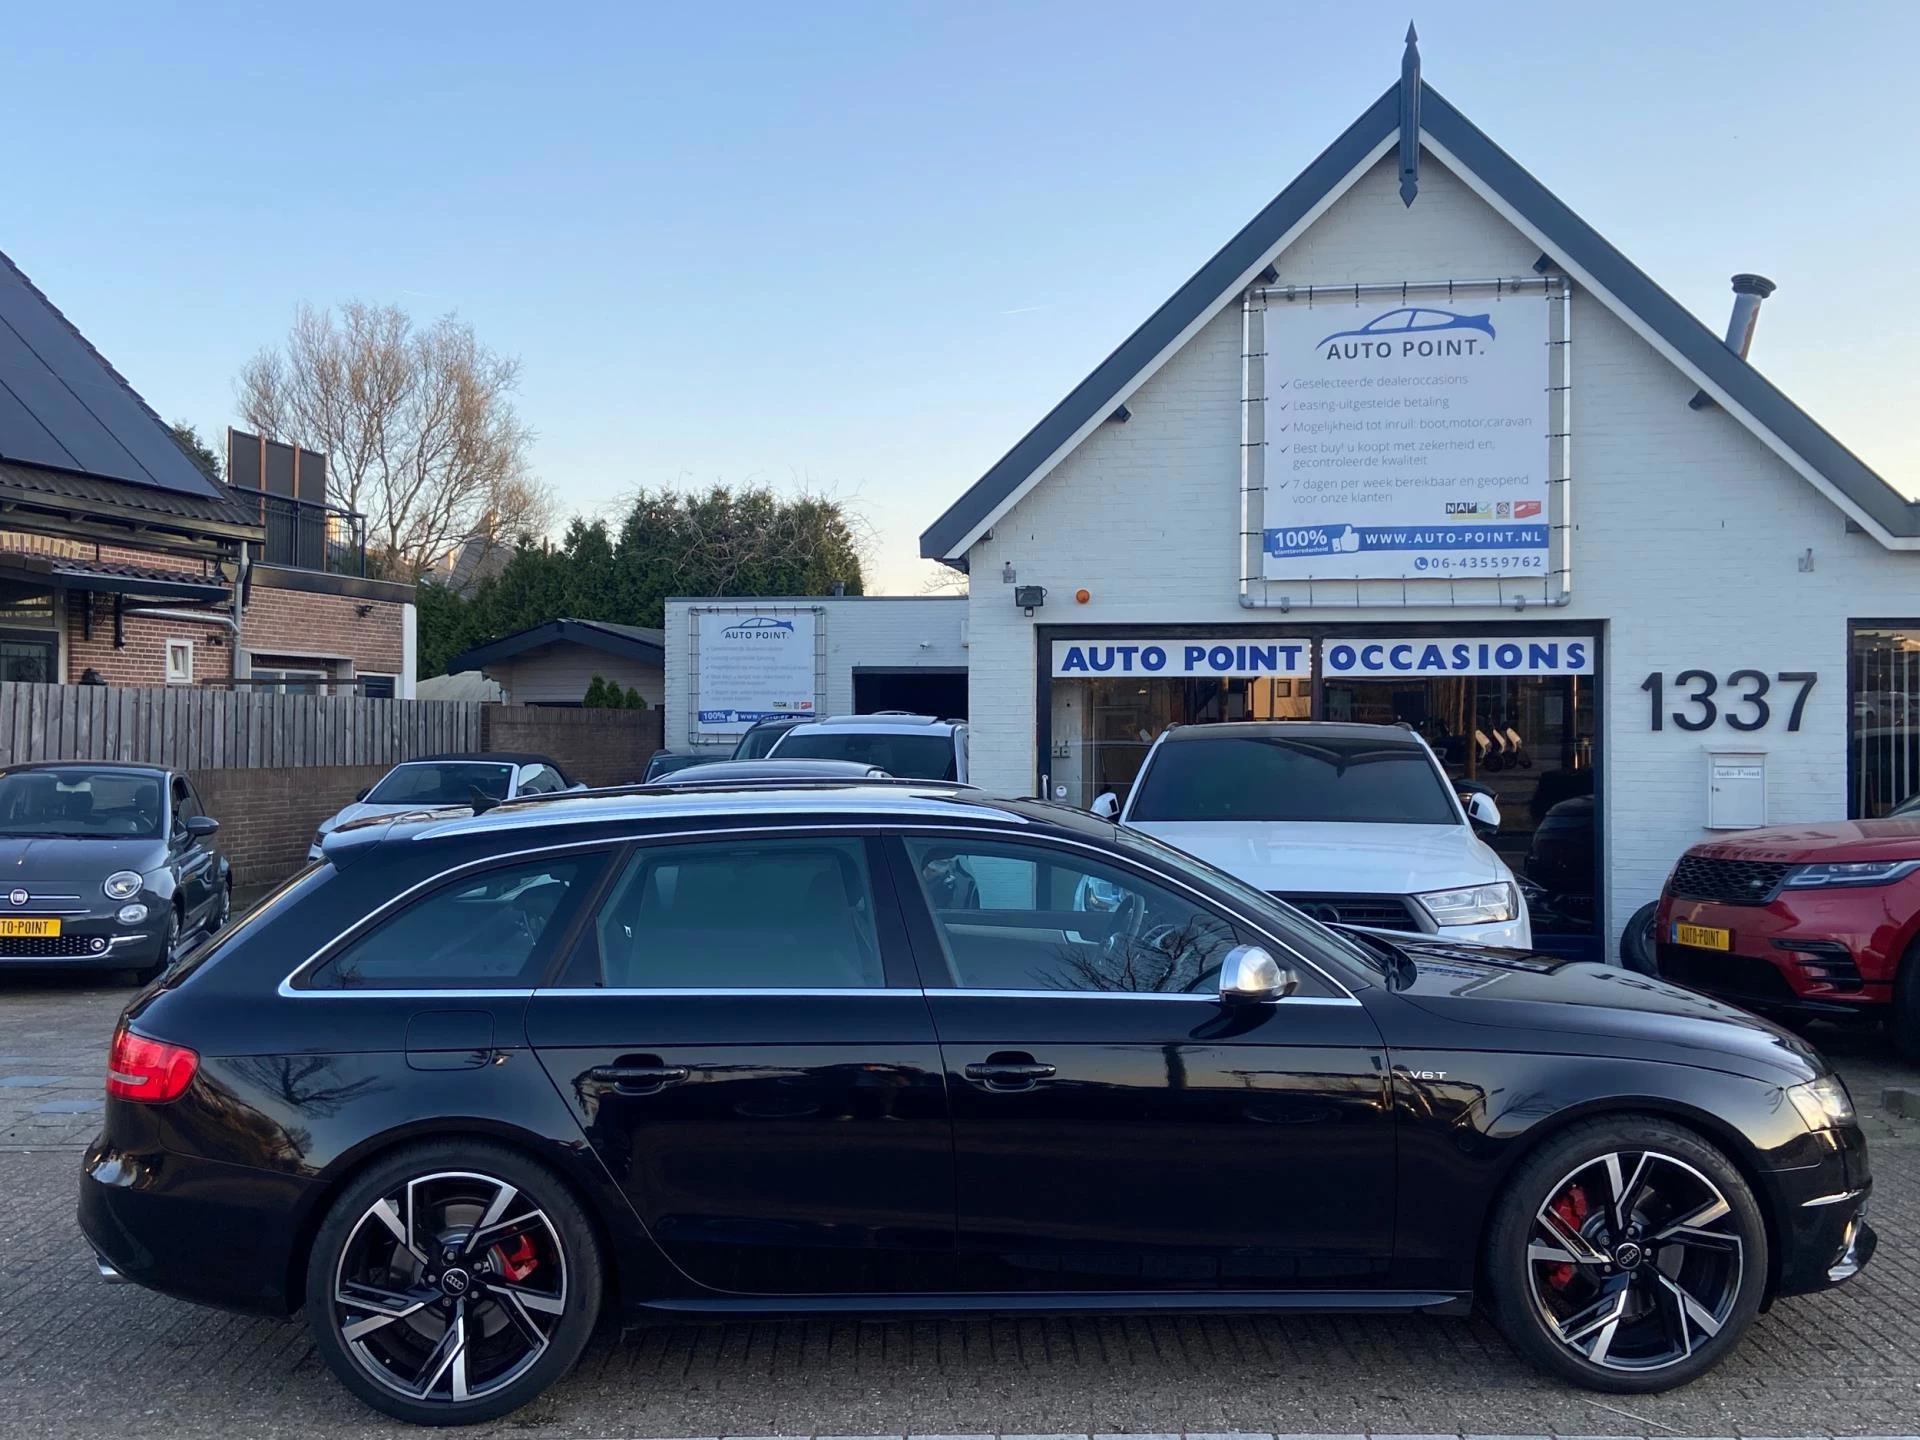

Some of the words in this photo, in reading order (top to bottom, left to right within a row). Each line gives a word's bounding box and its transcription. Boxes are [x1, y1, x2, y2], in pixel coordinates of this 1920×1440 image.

[1326, 341, 1392, 361] AUTO
[1401, 339, 1486, 358] POINT.
[1292, 375, 1374, 390] Geselecteerde
[1376, 373, 1469, 388] dealeroccasions
[1403, 395, 1450, 410] betaling
[1292, 419, 1365, 435] Mogelijkheid
[1366, 419, 1382, 431] tot
[1292, 442, 1318, 455] Best
[1320, 441, 1345, 456] buy!
[1347, 443, 1356, 454] u
[1357, 440, 1391, 455] koopt
[1393, 441, 1417, 453] met
[1418, 438, 1475, 452] zekerheid
[1292, 456, 1379, 471] gecontroleerde
[1293, 480, 1300, 489] 7
[1302, 478, 1338, 492] dagen
[1340, 478, 1361, 491] per
[1362, 477, 1393, 488] week
[1394, 475, 1457, 488] bereikbaar
[1459, 476, 1475, 487] en
[1476, 473, 1529, 489] geopend
[1292, 494, 1319, 504] voor
[1320, 493, 1348, 504] onze
[1351, 491, 1393, 503] klanten
[1446, 502, 1477, 514] NAP
[1274, 529, 1328, 548] 100%
[1365, 531, 1542, 544] WWW.AUTO-POINT.NL
[1430, 556, 1542, 569] 06-43559762
[724, 631, 752, 640] AUTO
[1061, 645, 1167, 672] AUTO
[1184, 644, 1303, 671] POINT
[1329, 642, 1586, 670] OCCASIONS
[1640, 669, 1818, 732] 1337
[703, 712, 725, 720] 100%
[1409, 1070, 1447, 1080] V6T
